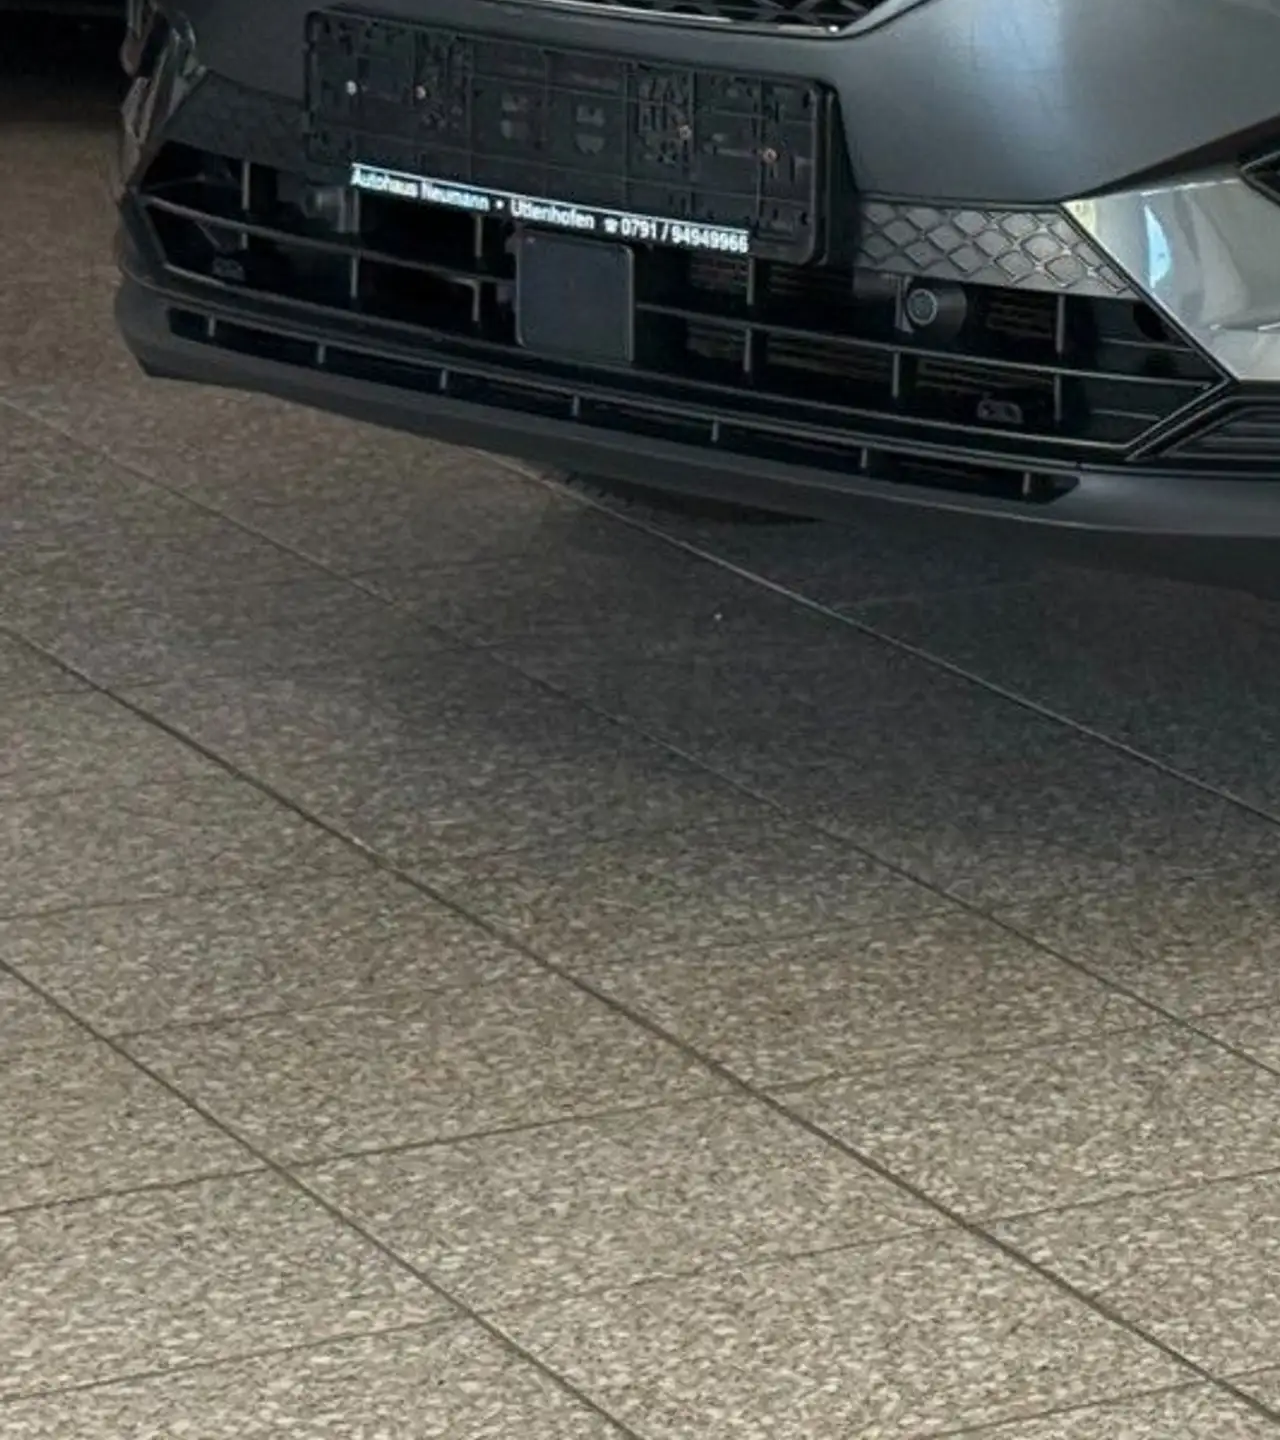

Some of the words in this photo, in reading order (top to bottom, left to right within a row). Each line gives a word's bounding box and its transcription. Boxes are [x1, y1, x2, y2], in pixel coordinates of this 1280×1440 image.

[351, 168, 418, 198] Autohaus
[421, 181, 490, 211] Neumann
[621, 216, 657, 239] 0791
